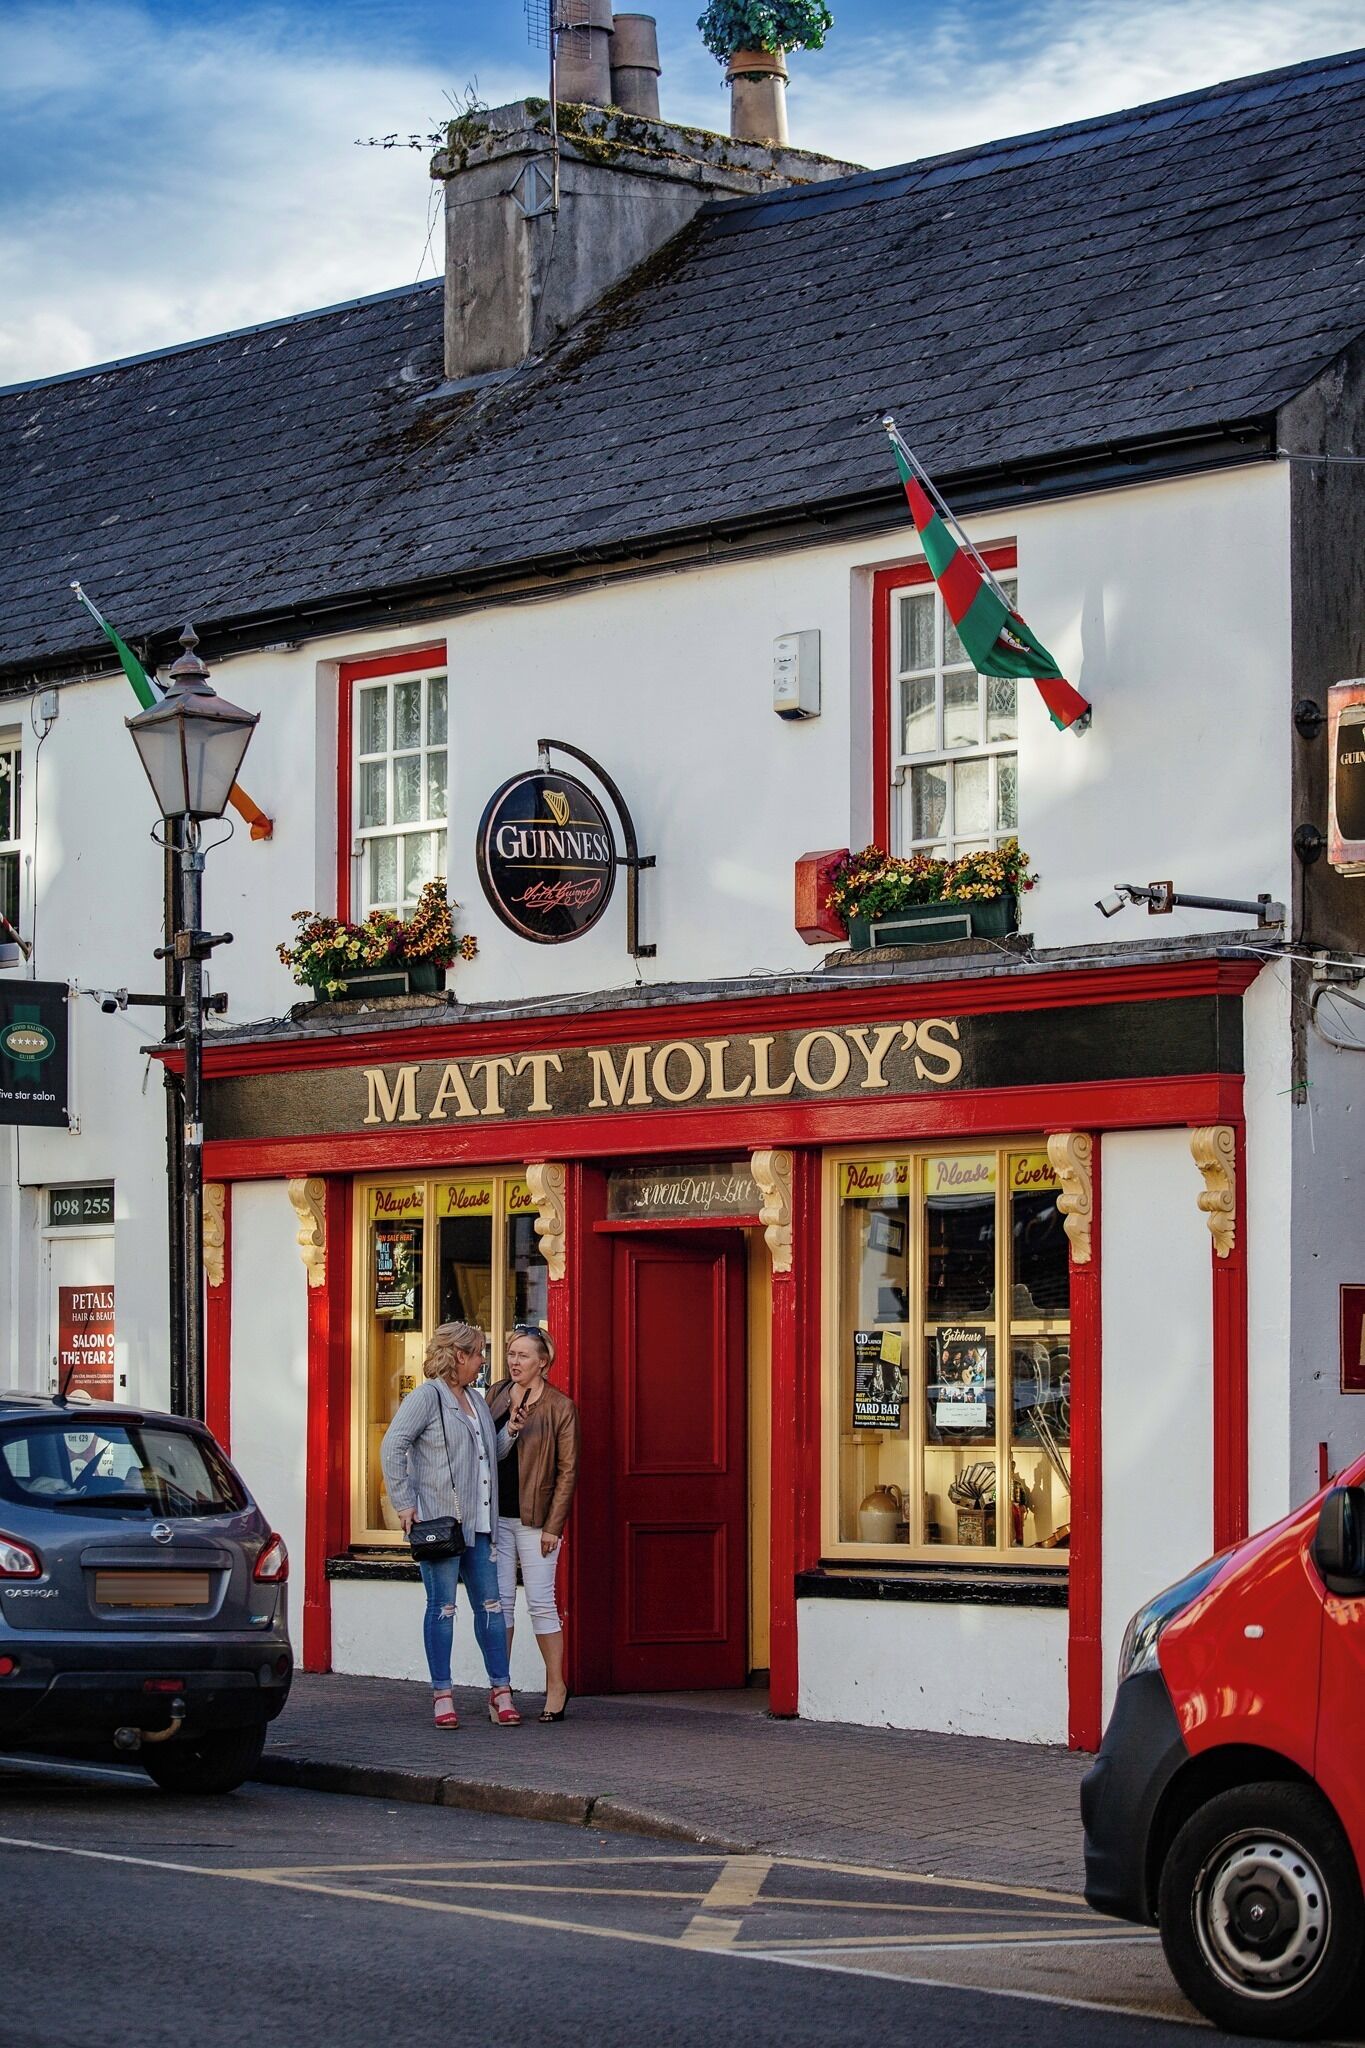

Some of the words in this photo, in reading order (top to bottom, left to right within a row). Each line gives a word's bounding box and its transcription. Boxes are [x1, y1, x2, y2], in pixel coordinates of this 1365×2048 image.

[496, 825, 610, 862] GUINNESS
[363, 1054, 563, 1124] MATT
[588, 1018, 963, 1107] MOLLOY'S
[15, 1091, 31, 1100] star
[33, 1091, 56, 1101] salon
[846, 1165, 909, 1194] Player's
[936, 1161, 989, 1191] Please
[54, 1200, 79, 1216] 098
[83, 1198, 110, 1214] 255
[375, 1191, 424, 1216] Player's
[447, 1187, 490, 1213] Please
[510, 1185, 533, 1209] Eve
[72, 1312, 88, 1322] HAIR
[89, 1312, 95, 1321] &
[72, 1334, 105, 1348] SALON
[855, 1333, 868, 1344] CD
[942, 1328, 982, 1349] Gatehouse
[61, 1351, 80, 1365] THE
[82, 1351, 106, 1364] YEAR
[855, 1402, 879, 1414] YARD
[881, 1403, 900, 1415] BAR
